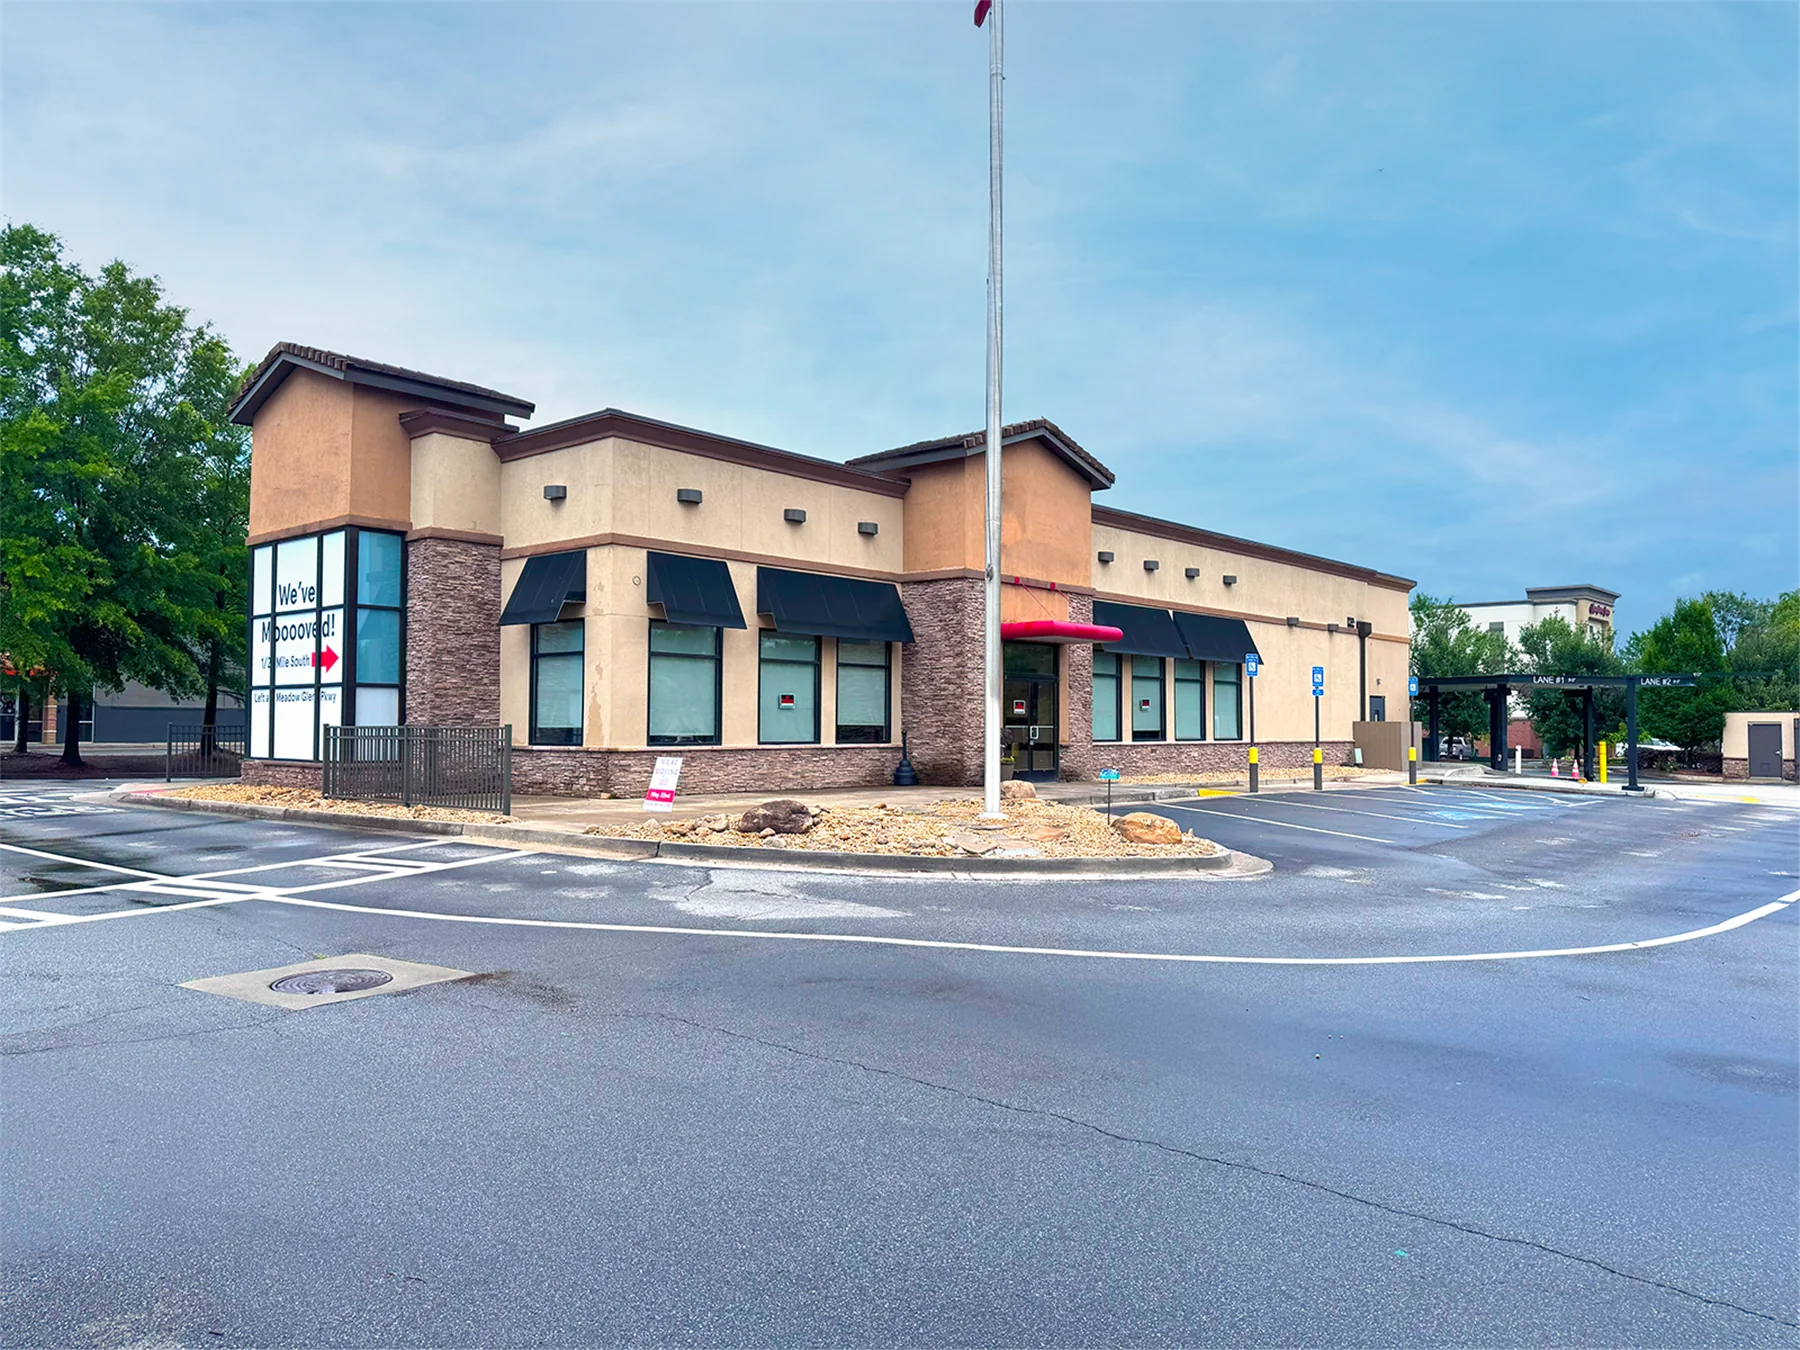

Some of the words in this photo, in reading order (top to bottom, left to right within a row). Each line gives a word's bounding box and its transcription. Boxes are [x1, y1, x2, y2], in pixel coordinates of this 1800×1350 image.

[279, 581, 315, 606] We've
[275, 655, 289, 668] Mile
[290, 654, 310, 667] South
[1533, 676, 1554, 684] LANE
[1640, 677, 1661, 686] LANE
[254, 692, 265, 703] Left
[276, 691, 300, 703] Meadow
[320, 690, 337, 704] Pkwy
